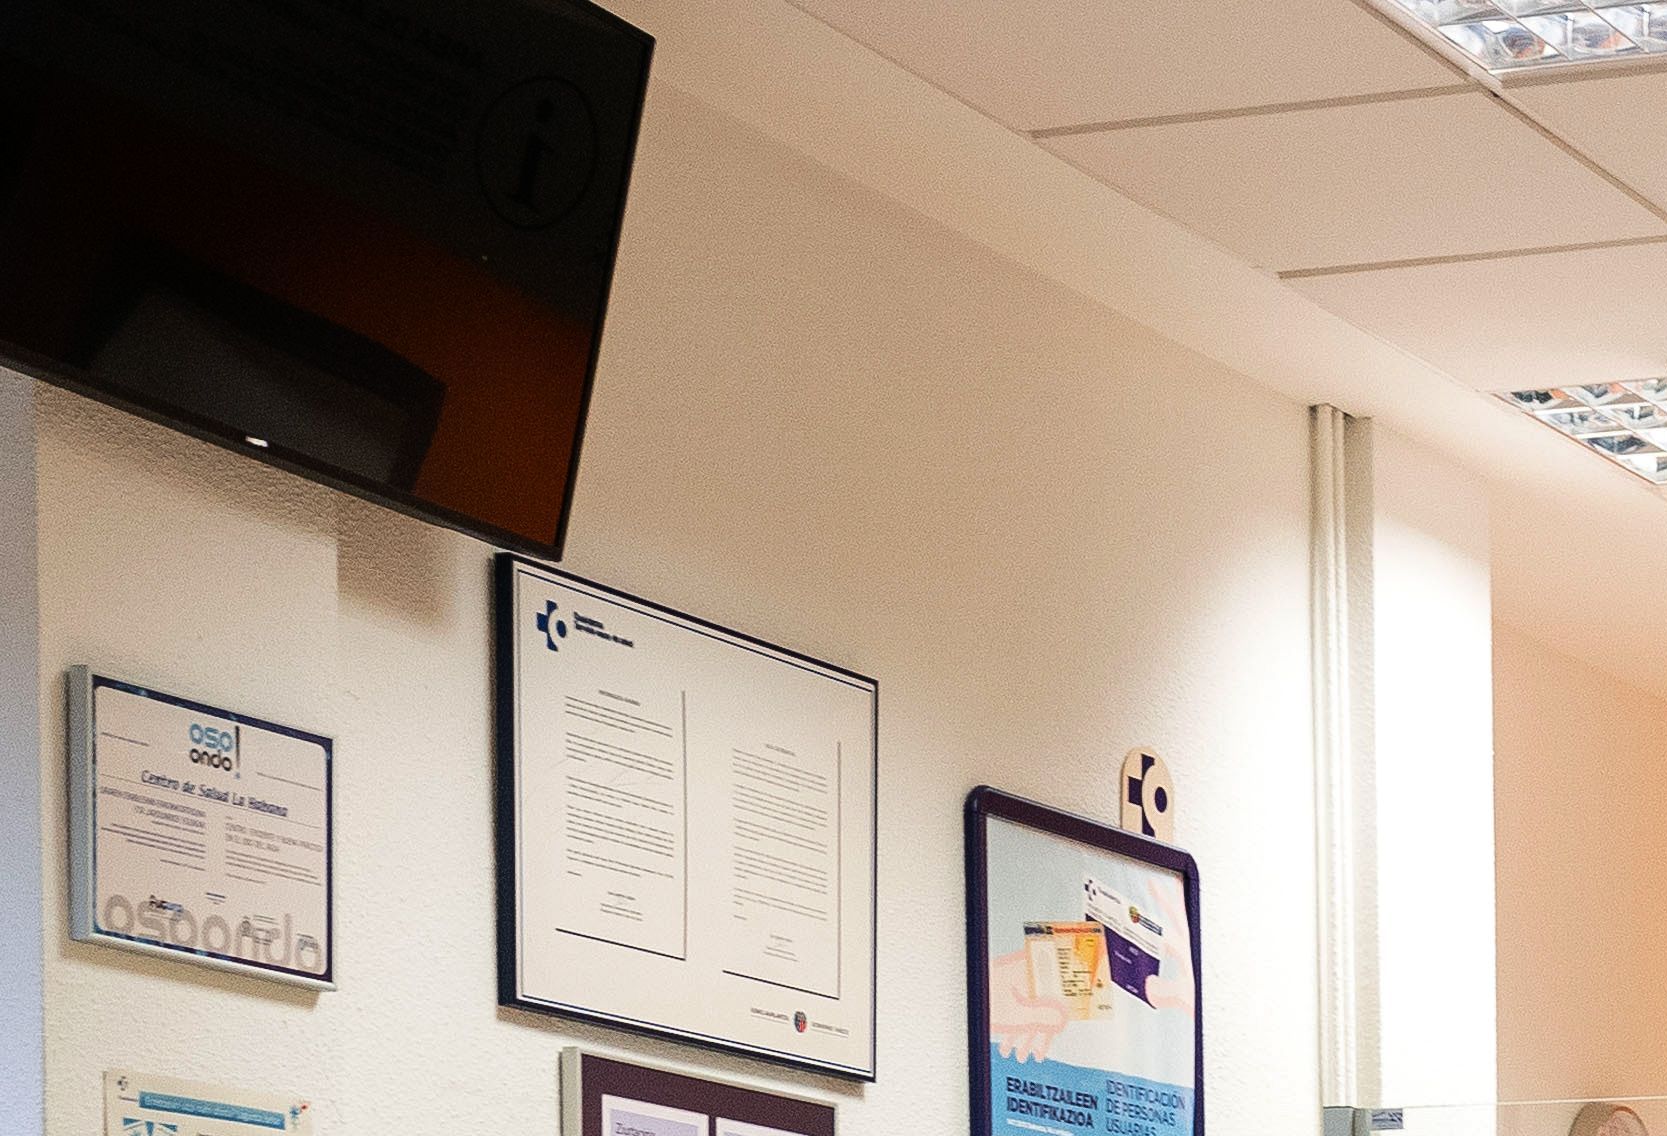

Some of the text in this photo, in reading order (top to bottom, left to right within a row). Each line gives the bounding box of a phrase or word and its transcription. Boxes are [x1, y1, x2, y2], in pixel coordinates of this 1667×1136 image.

[1006, 1076, 1098, 1110] ERABILTZAILEEN
[1006, 1096, 1095, 1129] IDENTIFIKAZIOA
[1105, 1098, 1176, 1127] DE PERSONAS
